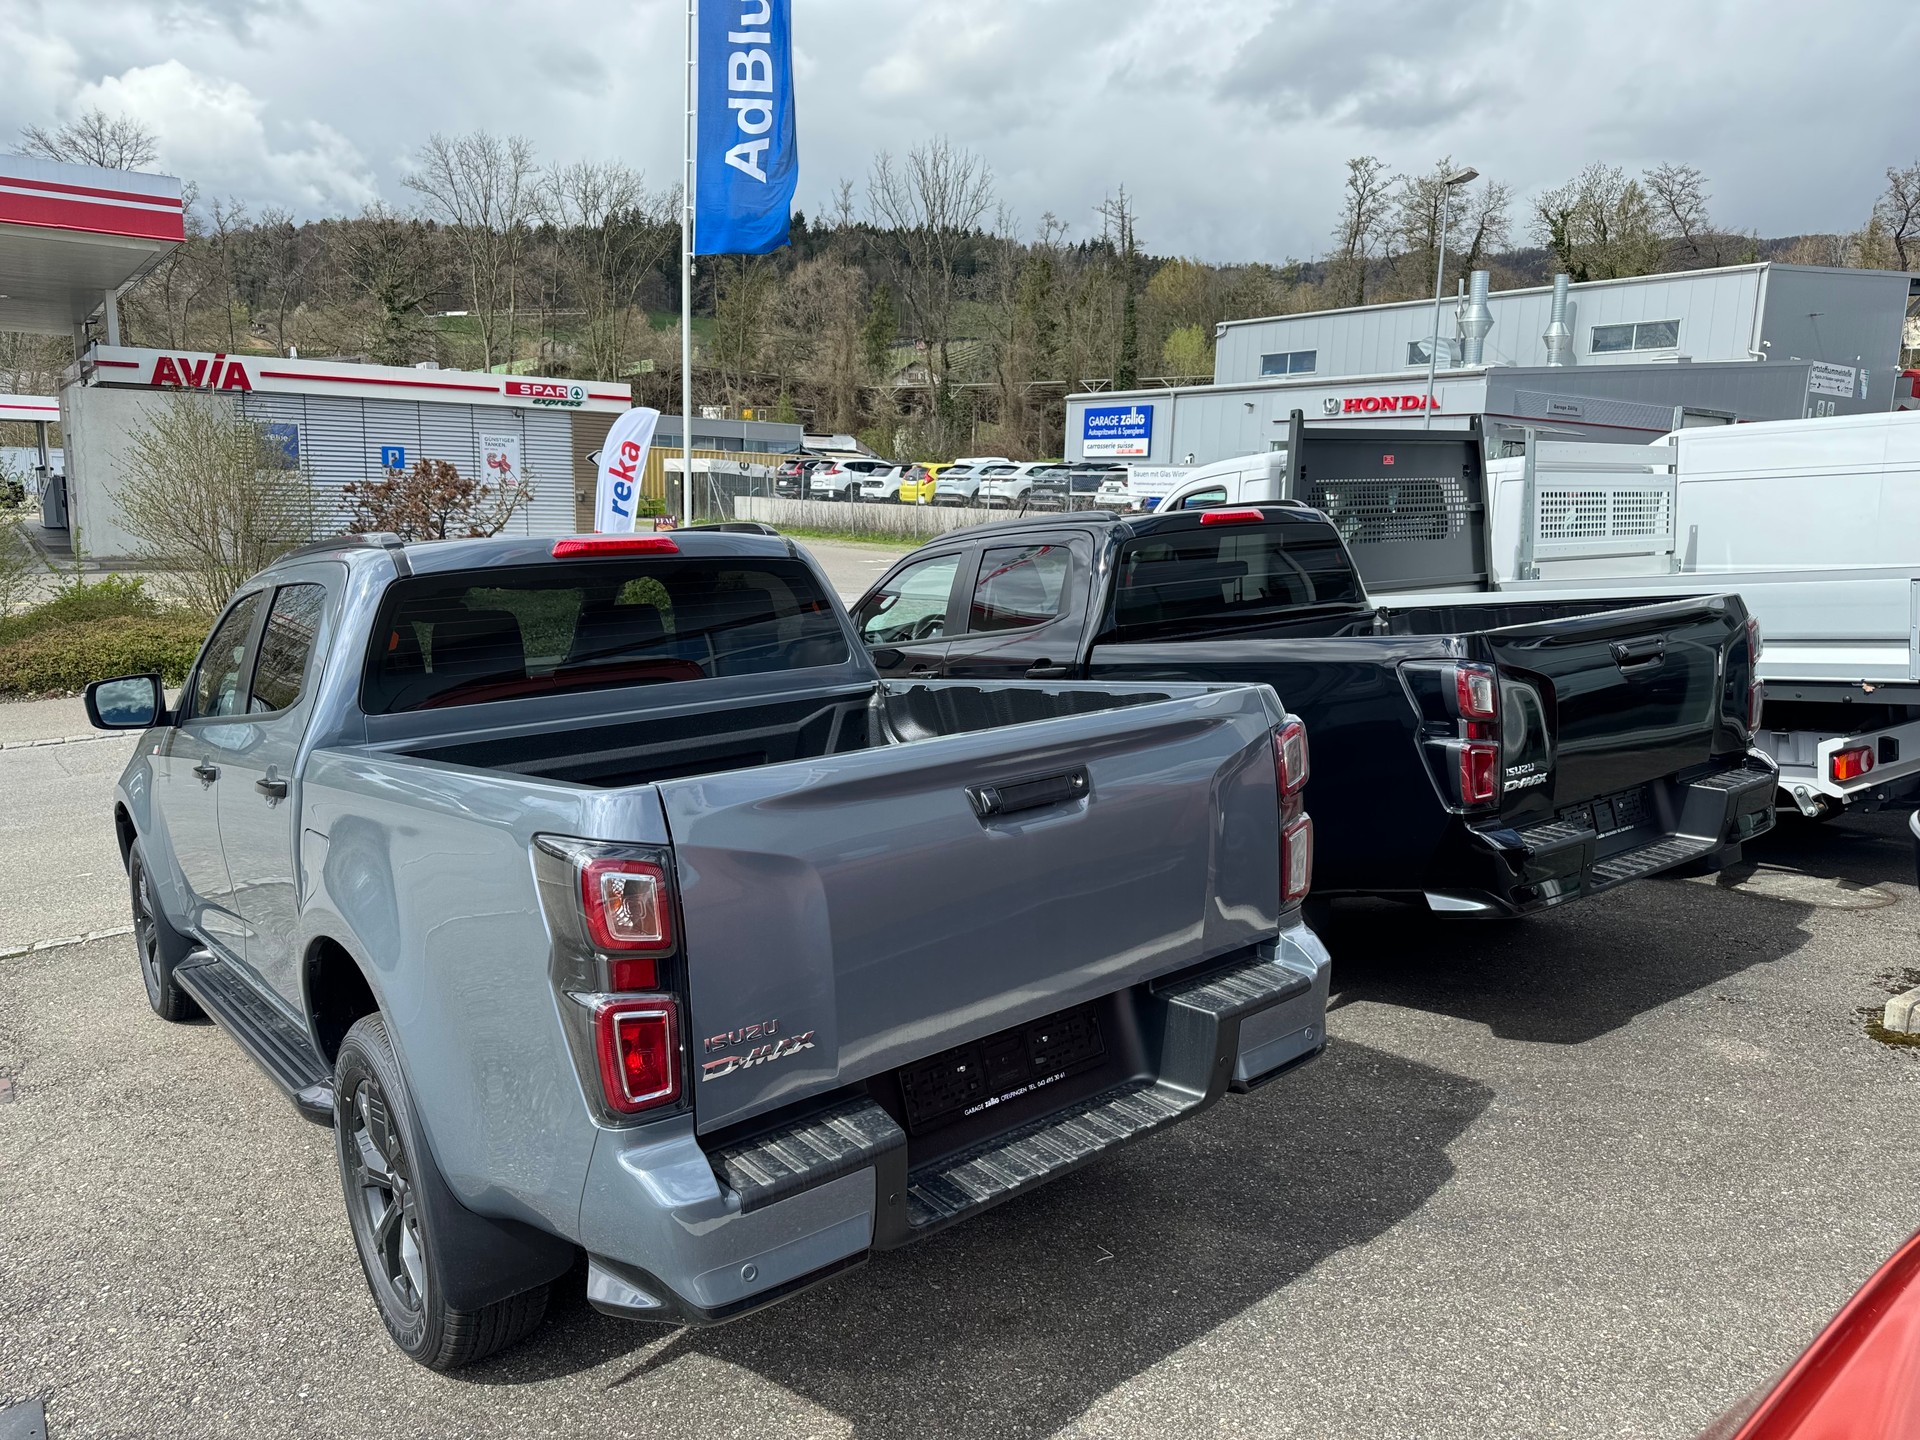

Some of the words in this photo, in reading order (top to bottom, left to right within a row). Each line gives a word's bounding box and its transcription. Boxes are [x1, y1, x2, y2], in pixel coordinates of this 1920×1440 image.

[520, 384, 567, 397] SPAR
[532, 398, 583, 408] express
[1342, 394, 1440, 413] HONDA
[1088, 415, 1119, 426] GARAGE
[1118, 427, 1122, 435] &
[1122, 427, 1145, 437] Spenglerei
[484, 436, 515, 444] GÜNSTIGER
[1086, 442, 1116, 450] carrosserie
[1117, 441, 1134, 449] suisse
[388, 450, 400, 468] P
[608, 440, 641, 518] reka
[1133, 470, 1149, 478] Bauen
[1150, 470, 1159, 478] mit
[1159, 470, 1171, 478] Glas
[1505, 762, 1535, 777] ISUZU
[703, 1019, 780, 1054] ISUZU
[701, 1030, 815, 1082] D-MAX
[964, 1103, 984, 1116] GARAGE
